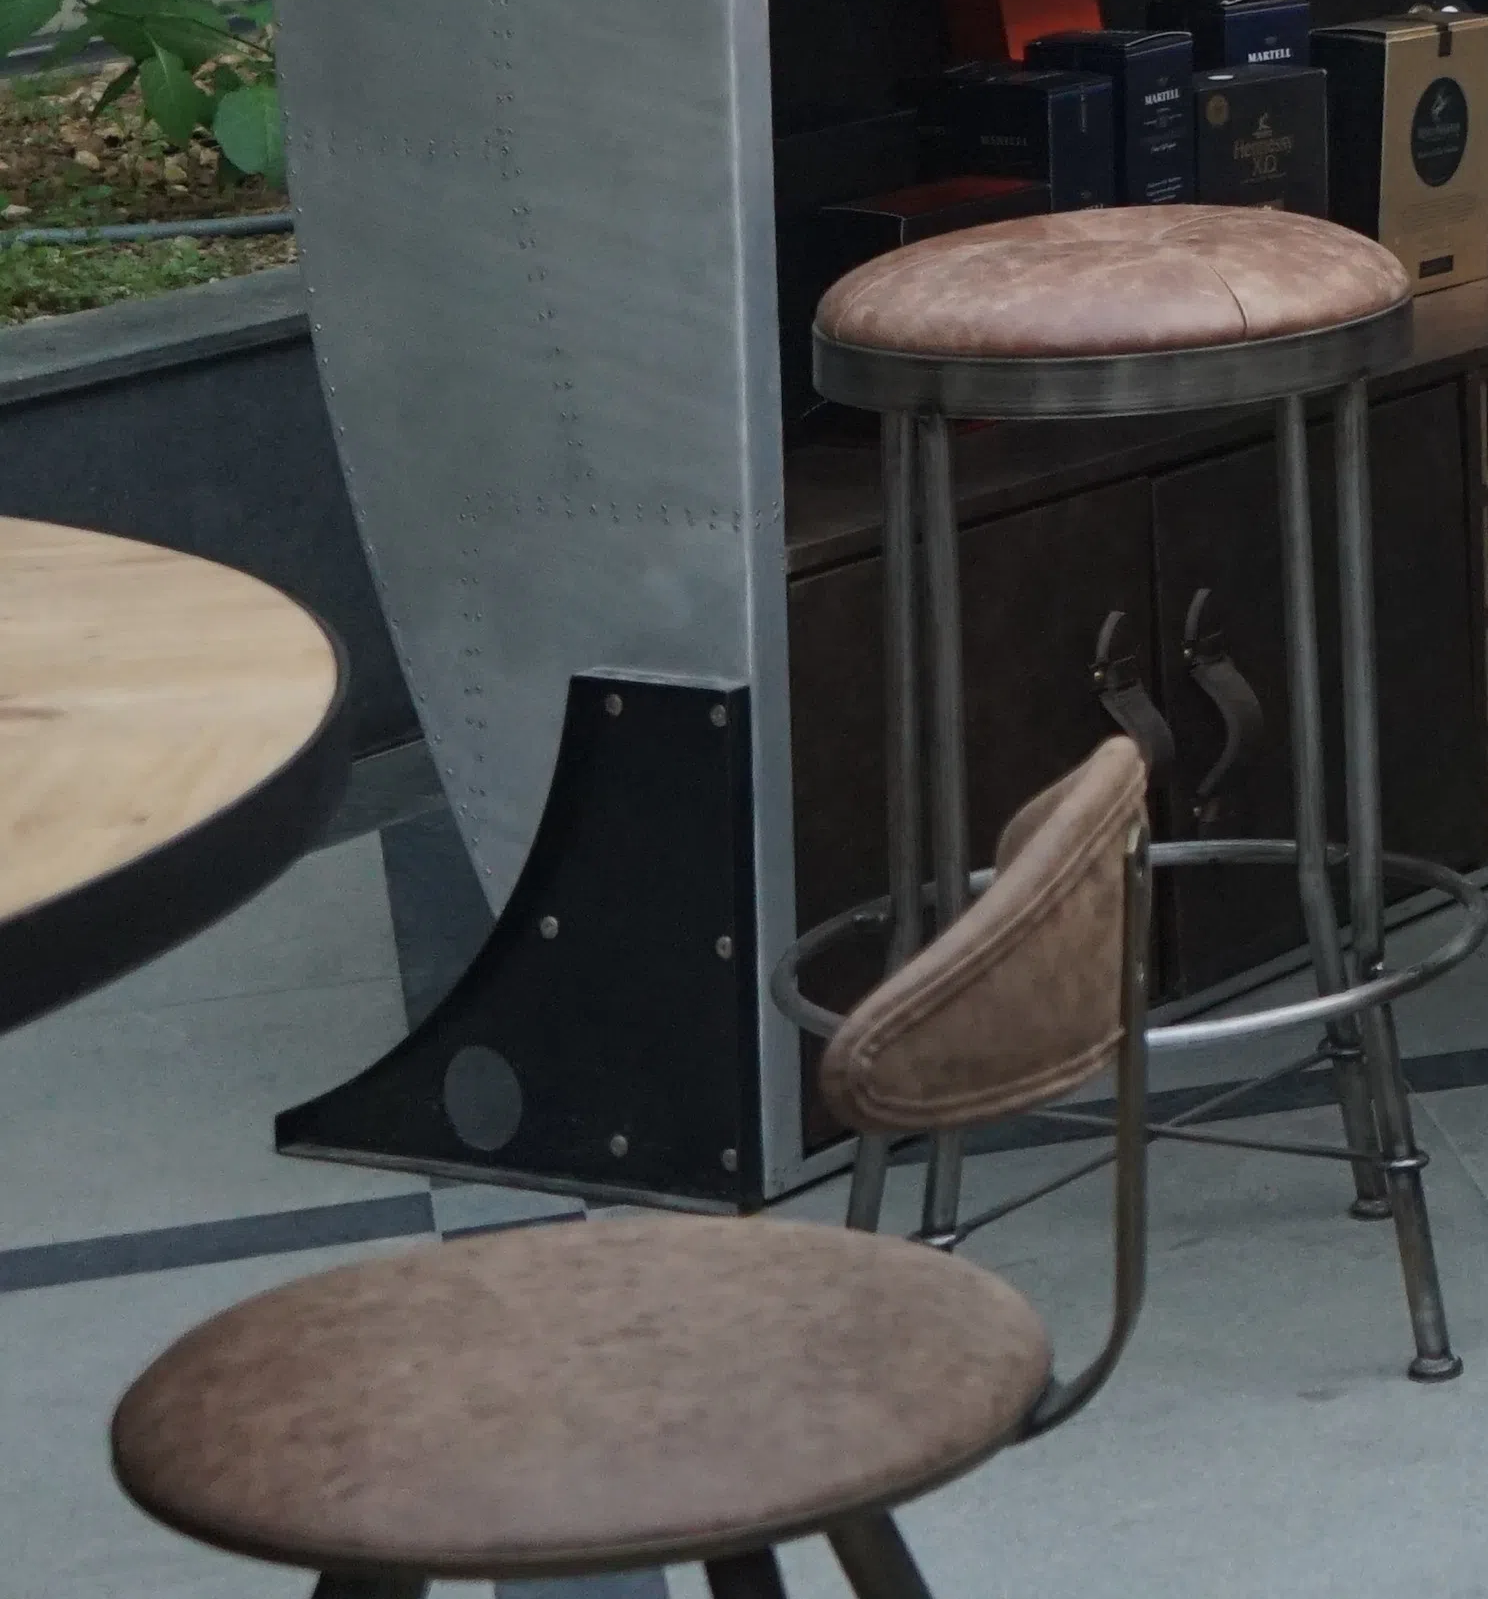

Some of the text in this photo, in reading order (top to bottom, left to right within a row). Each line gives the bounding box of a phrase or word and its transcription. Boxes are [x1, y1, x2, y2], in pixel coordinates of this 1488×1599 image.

[1246, 46, 1293, 65] MARTELL
[1142, 86, 1182, 107] MARTELL
[1231, 133, 1296, 161] Hennessy
